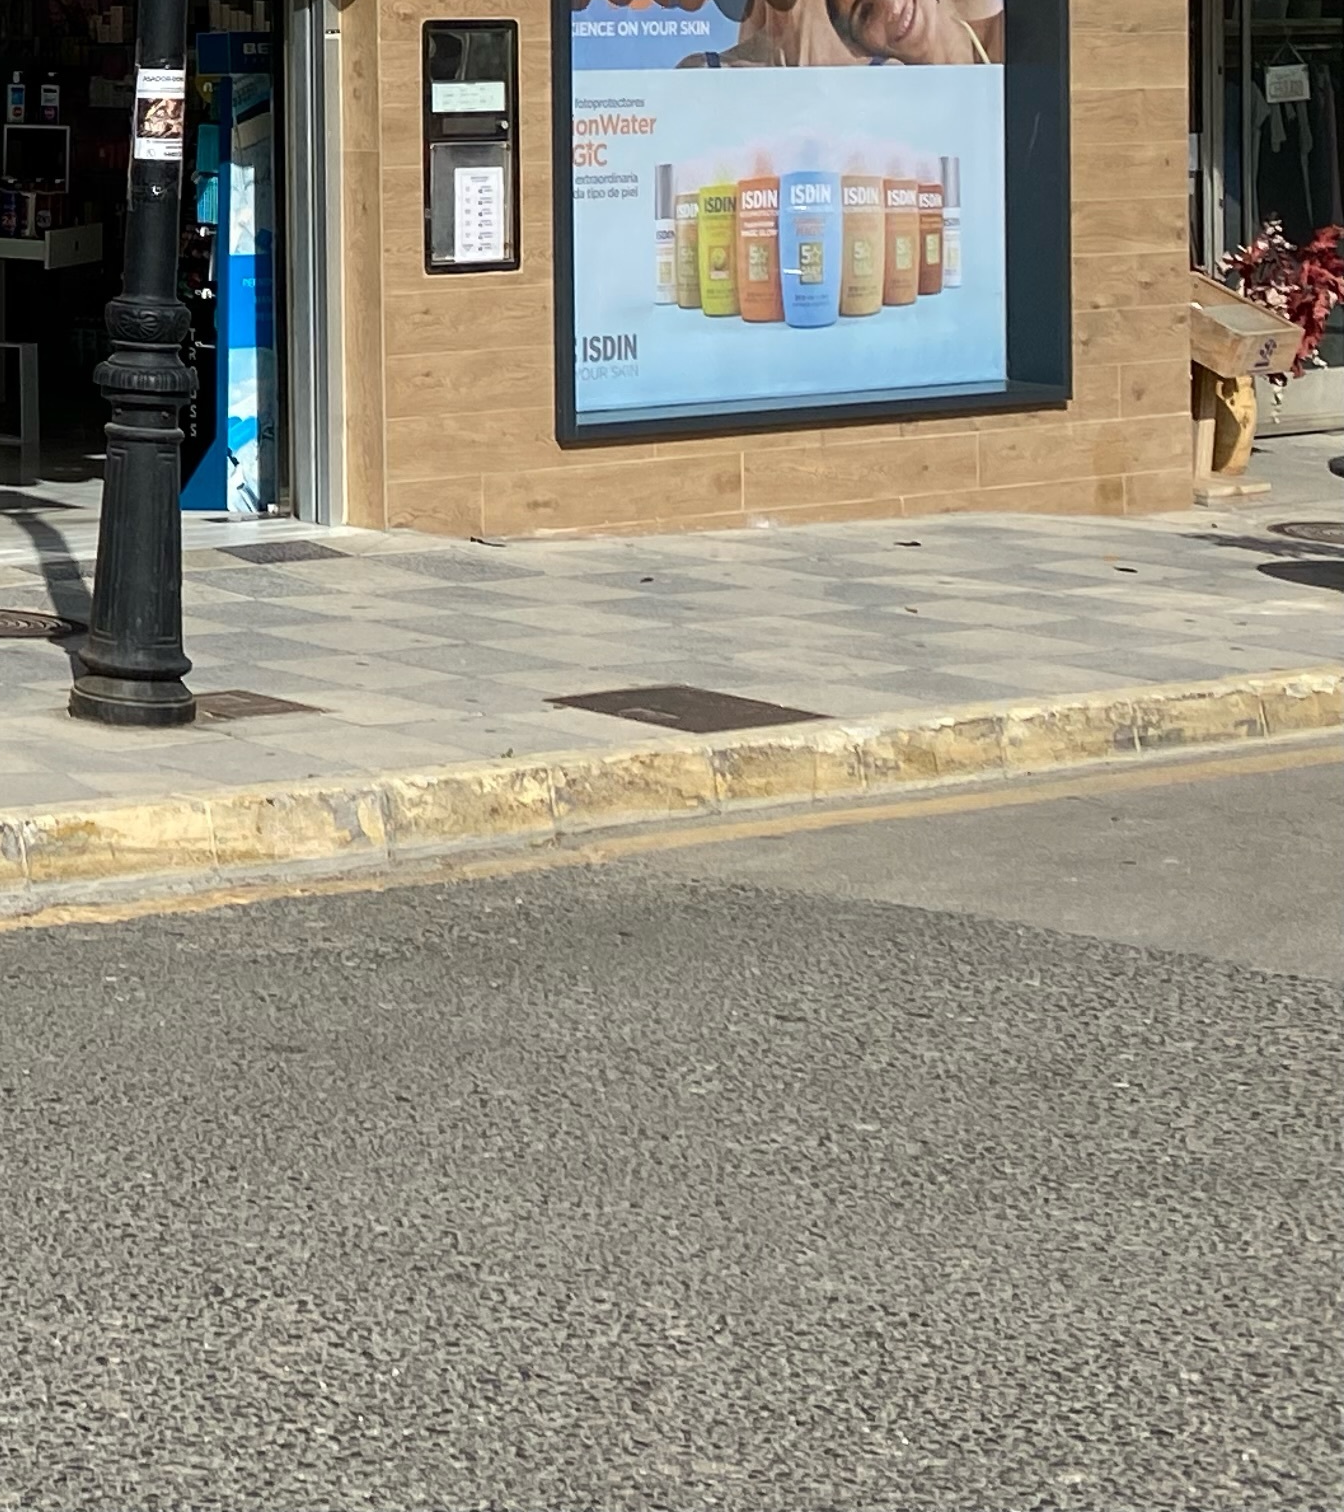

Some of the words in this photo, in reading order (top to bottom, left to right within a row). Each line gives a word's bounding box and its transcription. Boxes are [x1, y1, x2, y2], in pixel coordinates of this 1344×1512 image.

[617, 20, 639, 37] ON
[641, 20, 679, 36] YOUR
[680, 20, 711, 36] SKIN
[575, 172, 639, 186] extraordinaria
[587, 188, 606, 201] tipo
[608, 187, 620, 199] de
[622, 186, 639, 200] piel
[742, 190, 779, 209] ISDIN
[791, 184, 832, 205] ISDIN
[844, 186, 881, 206] ISDIN
[888, 190, 917, 206] ISDIN
[705, 196, 737, 214] ISDIN
[583, 334, 638, 363] ISDIN
